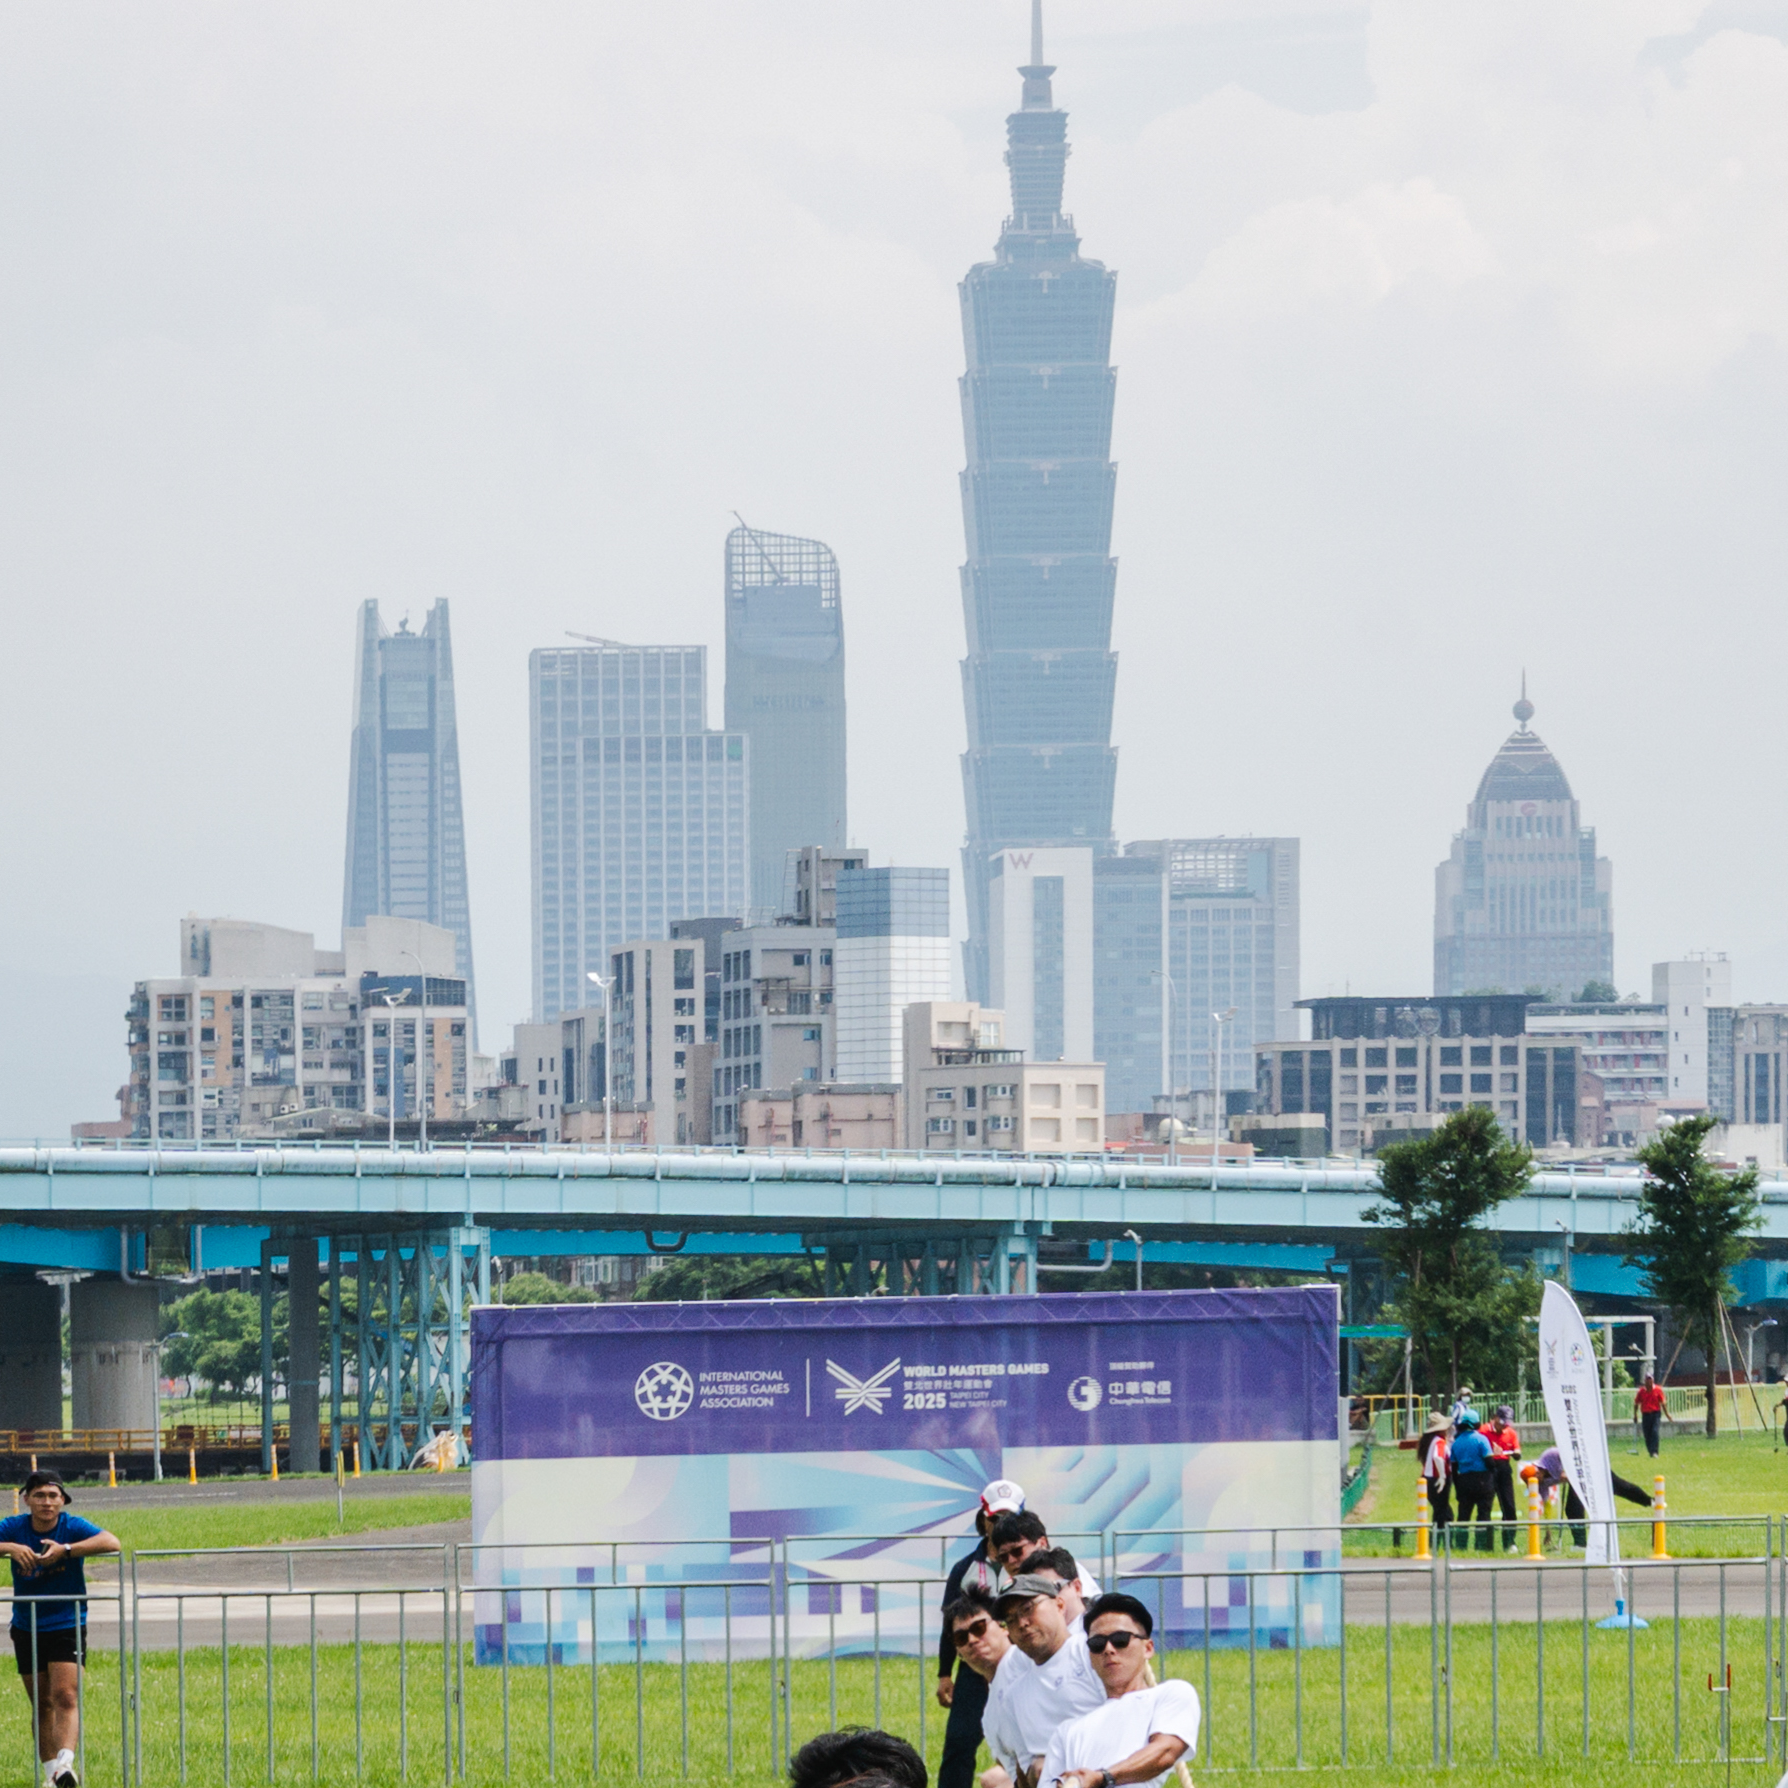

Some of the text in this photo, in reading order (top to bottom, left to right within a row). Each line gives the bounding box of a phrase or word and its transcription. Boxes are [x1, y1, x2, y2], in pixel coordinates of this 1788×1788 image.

[1009, 853, 1034, 870] W
[699, 1370, 784, 1382] INTERNATIONAL
[903, 1363, 1050, 1377] WORLD MASTERS GAMES
[699, 1383, 790, 1396] MASTERS GAMES
[1108, 1380, 1172, 1395] 中華電信
[699, 1397, 774, 1409] ASSOCIATION
[903, 1391, 989, 1410] 2025 TAIPEI CITY
[968, 1400, 990, 1408] TAIPEI
